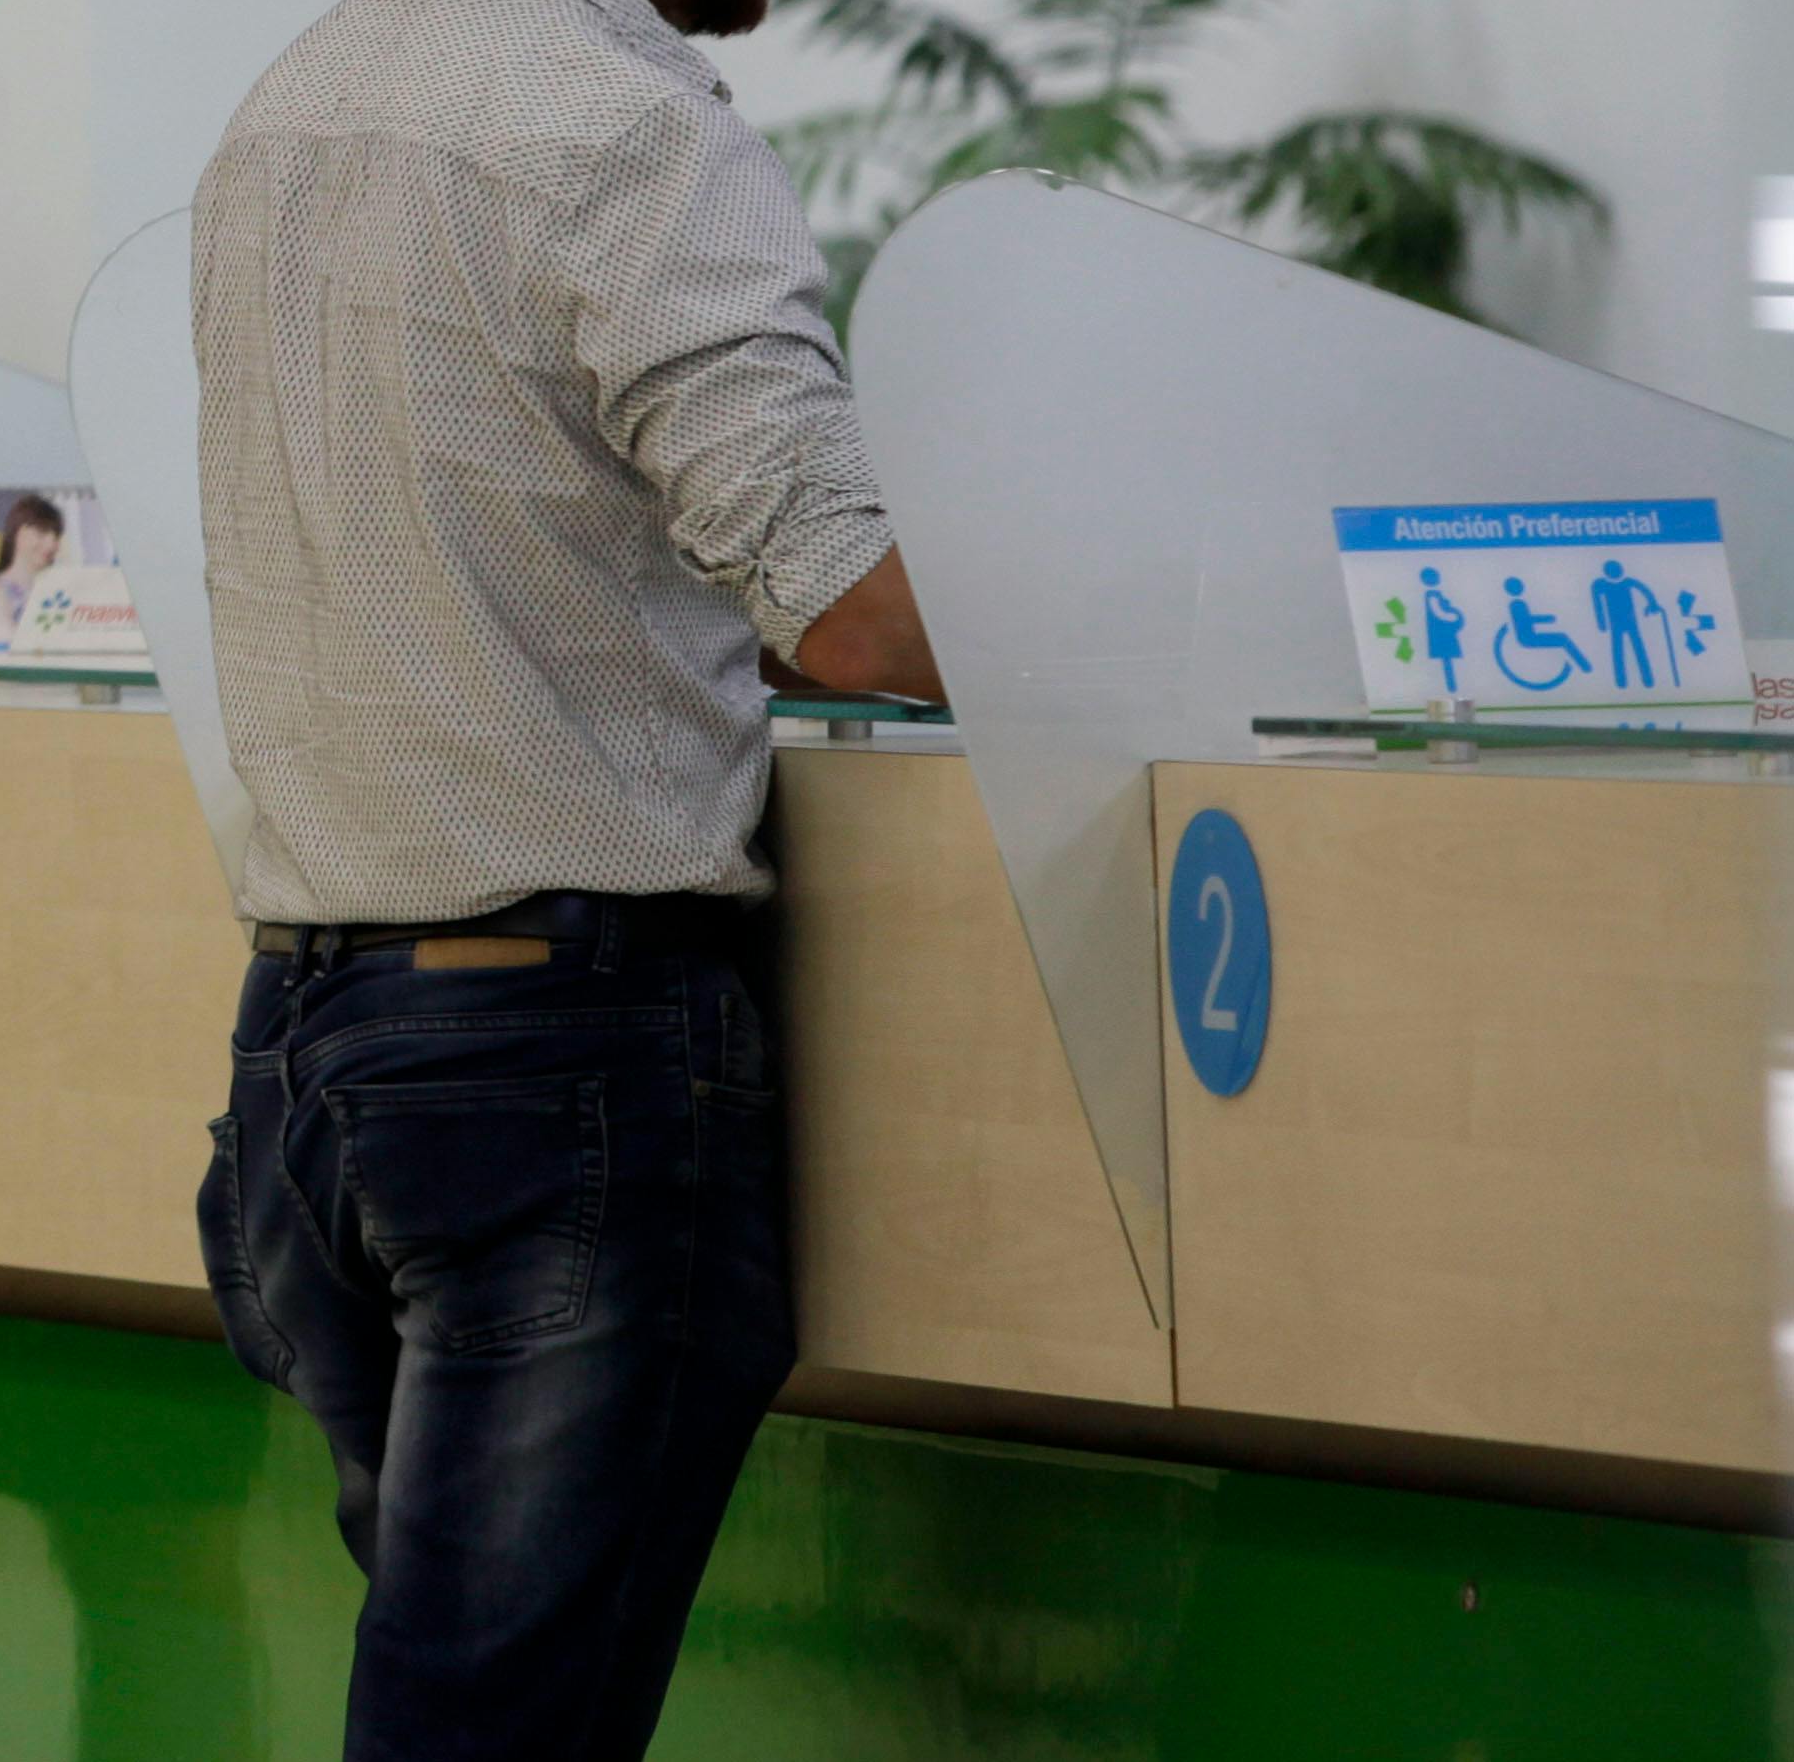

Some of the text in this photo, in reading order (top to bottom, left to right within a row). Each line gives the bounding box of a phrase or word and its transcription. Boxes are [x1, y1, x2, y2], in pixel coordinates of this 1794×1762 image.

[1395, 509, 1660, 542] Atención Preferencial
[1197, 875, 1238, 1031] 2
